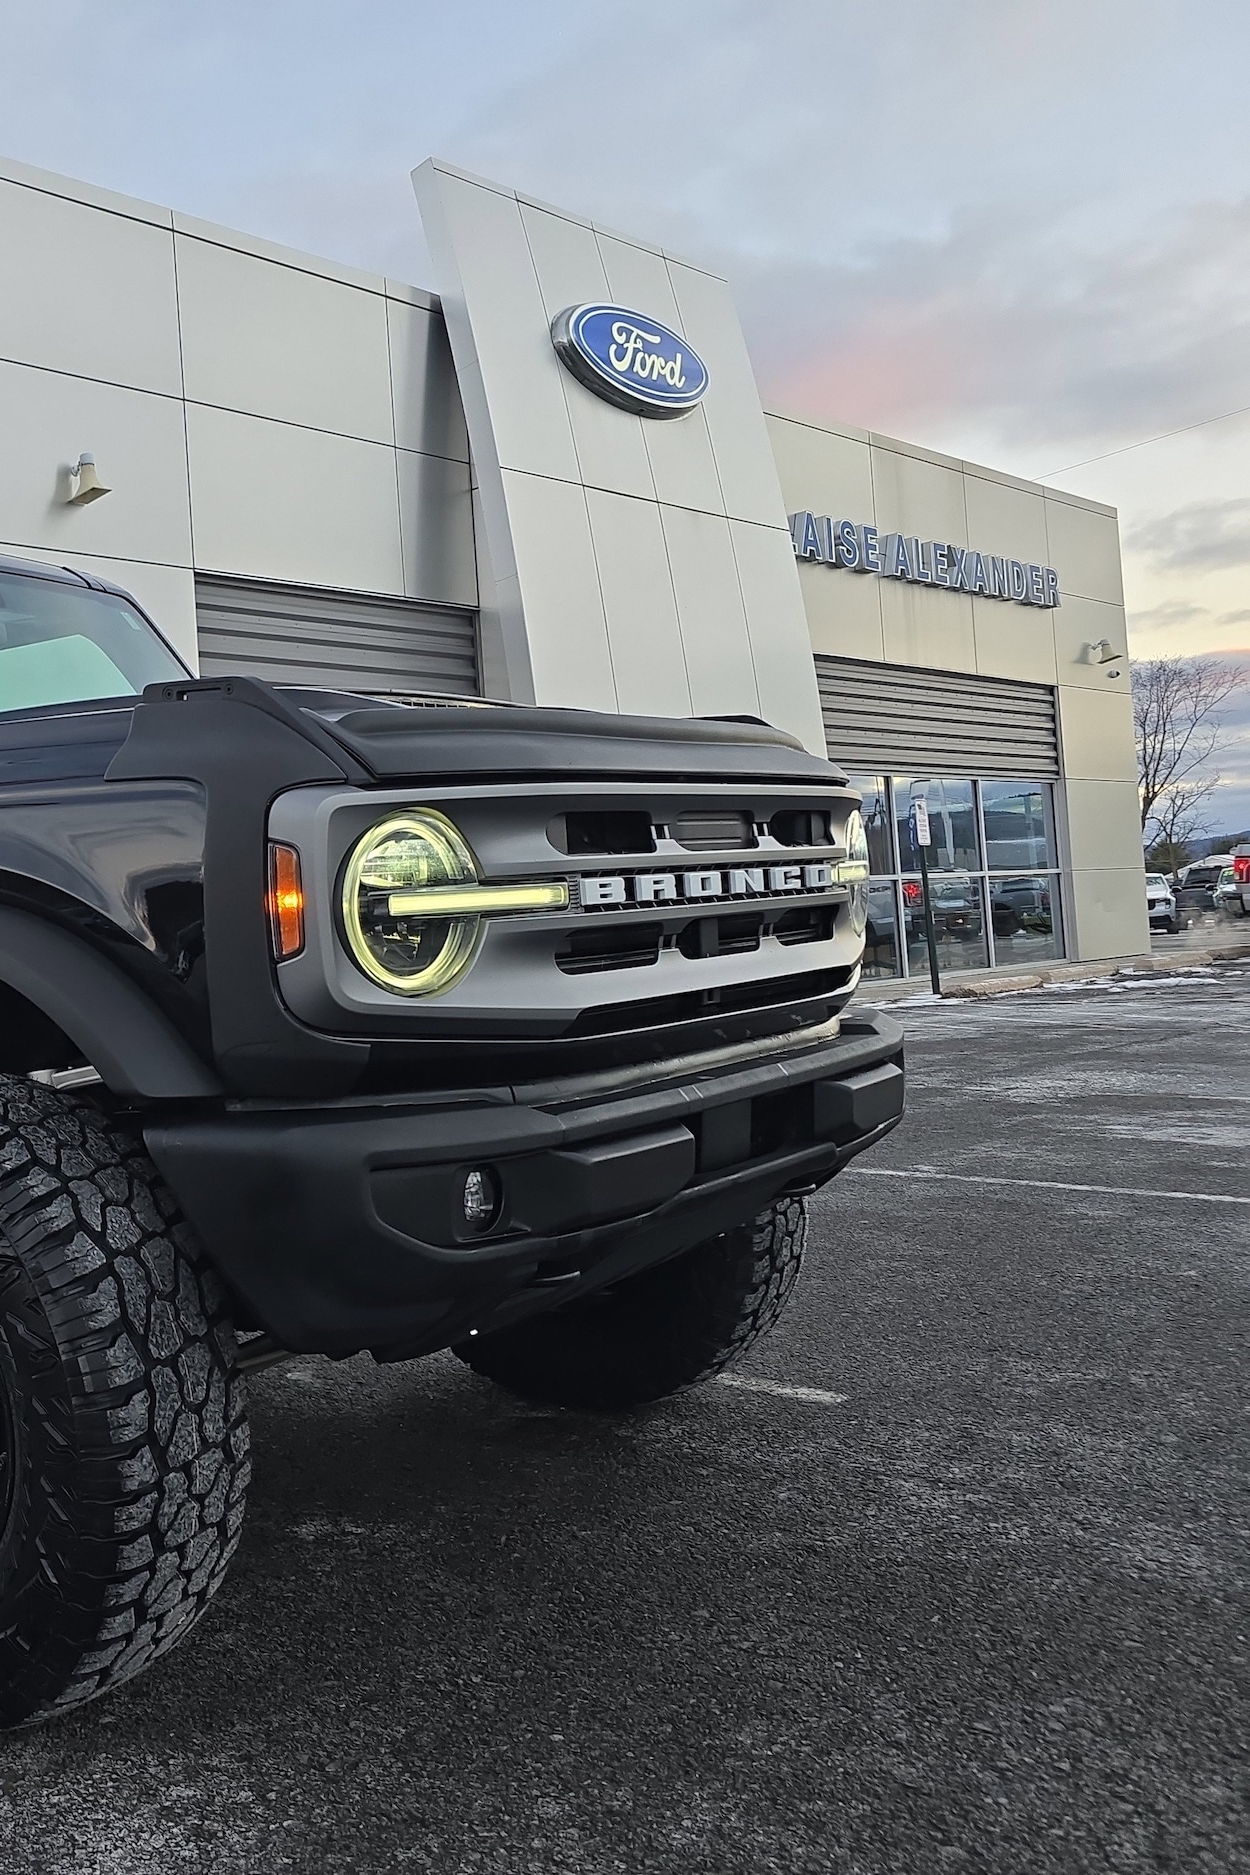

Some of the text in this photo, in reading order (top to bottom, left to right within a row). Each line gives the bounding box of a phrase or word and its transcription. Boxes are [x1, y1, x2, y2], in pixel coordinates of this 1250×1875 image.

[609, 321, 686, 389] Ford
[791, 510, 1061, 608] AISE ALEXANDER
[580, 864, 833, 906] BRONCO
